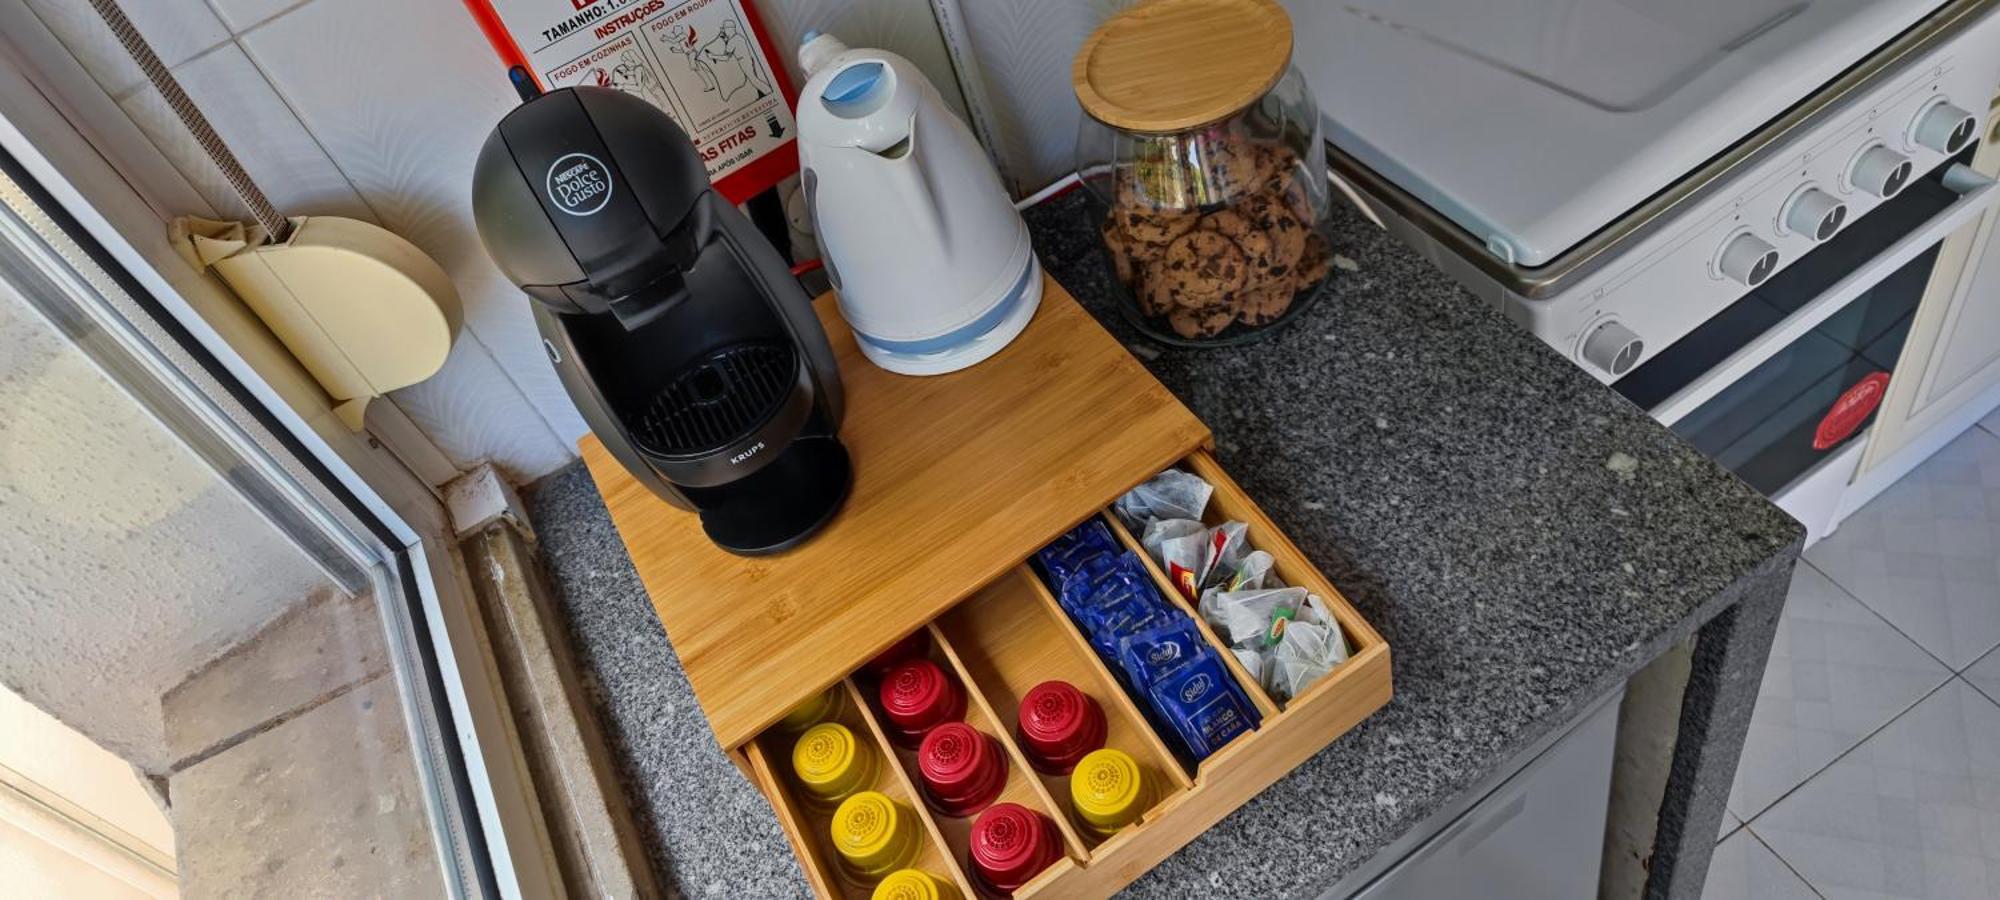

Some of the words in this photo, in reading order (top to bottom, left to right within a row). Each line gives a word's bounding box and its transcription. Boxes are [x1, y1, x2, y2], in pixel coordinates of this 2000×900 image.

[542, 6, 607, 42] TAMANHO:
[652, 17, 674, 33] FOGO
[675, 9, 688, 22] EM
[554, 64, 578, 81] FOGO
[579, 57, 592, 70] EM
[591, 37, 633, 62] COZINHAS
[718, 126, 757, 153] FITAS
[735, 148, 754, 163] USAR
[556, 170, 600, 198] Dolce
[565, 180, 606, 207] Gusto
[730, 441, 766, 464] KRUPS
